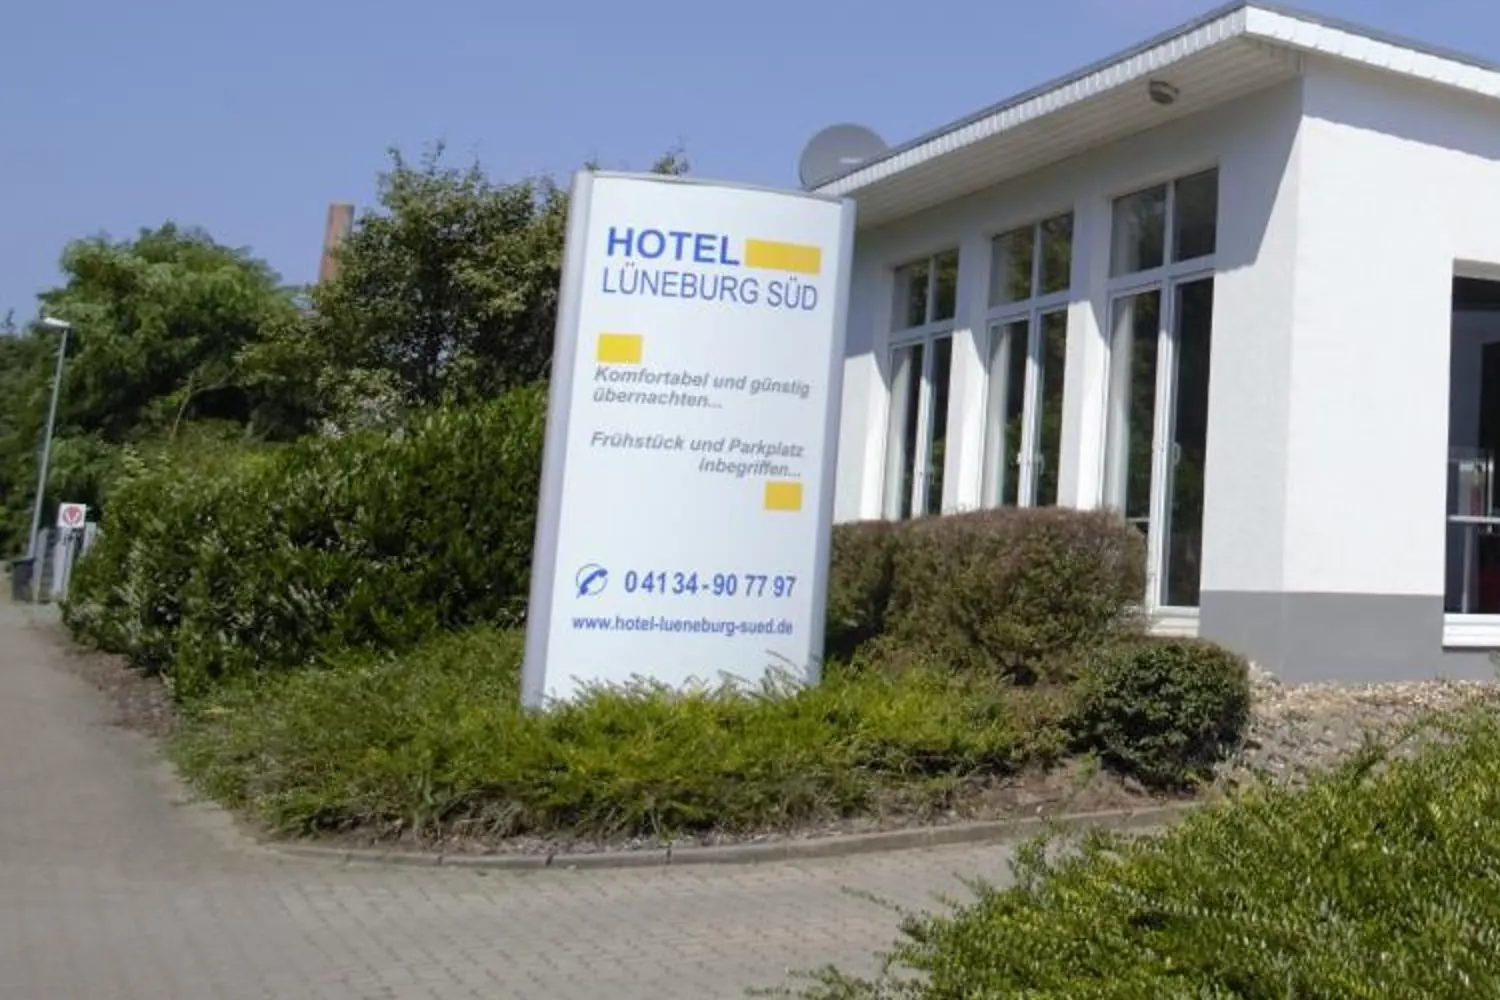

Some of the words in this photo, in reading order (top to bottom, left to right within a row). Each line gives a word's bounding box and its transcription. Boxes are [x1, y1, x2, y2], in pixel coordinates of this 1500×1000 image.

[607, 226, 740, 266] HOTEL
[602, 262, 759, 305] LÜNEBURG
[766, 275, 818, 311] SÜD
[594, 367, 710, 388] Komfortabel
[713, 375, 747, 391] und
[751, 379, 810, 398] günstig
[593, 387, 723, 409] übernachten...
[590, 431, 685, 452] Frühstück
[690, 437, 724, 453] und
[729, 438, 805, 459] Parkplatz
[698, 457, 801, 478] inbegriffen...
[572, 615, 793, 637] www.hotel-lueneburg-sued.de
